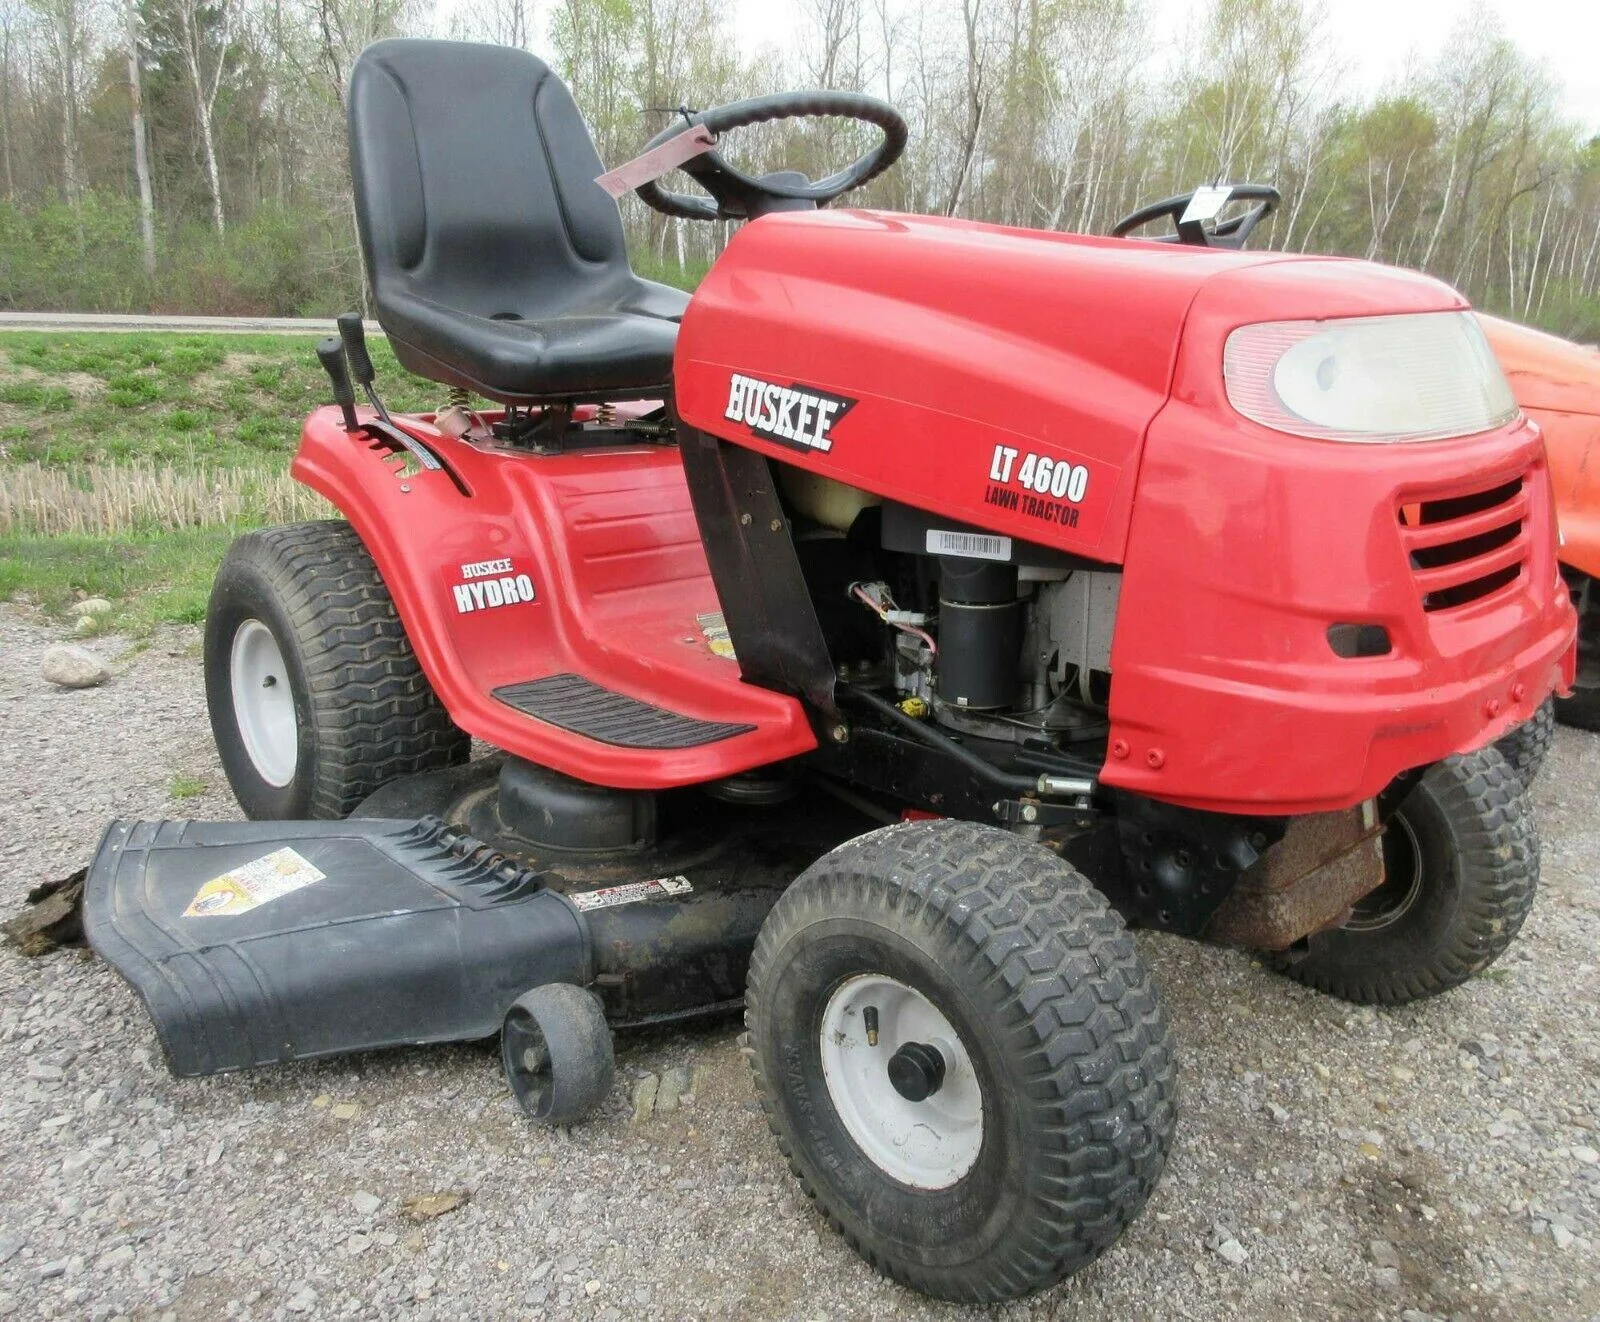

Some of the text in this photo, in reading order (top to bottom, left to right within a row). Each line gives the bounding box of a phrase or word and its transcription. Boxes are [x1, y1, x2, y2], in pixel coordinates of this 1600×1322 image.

[724, 373, 839, 452] HUSKEE
[989, 444, 1090, 504] LT 4600
[984, 484, 1080, 529] LAWN TRACTOR
[461, 558, 514, 579] HUSKEE
[453, 574, 535, 613] HYDRO
